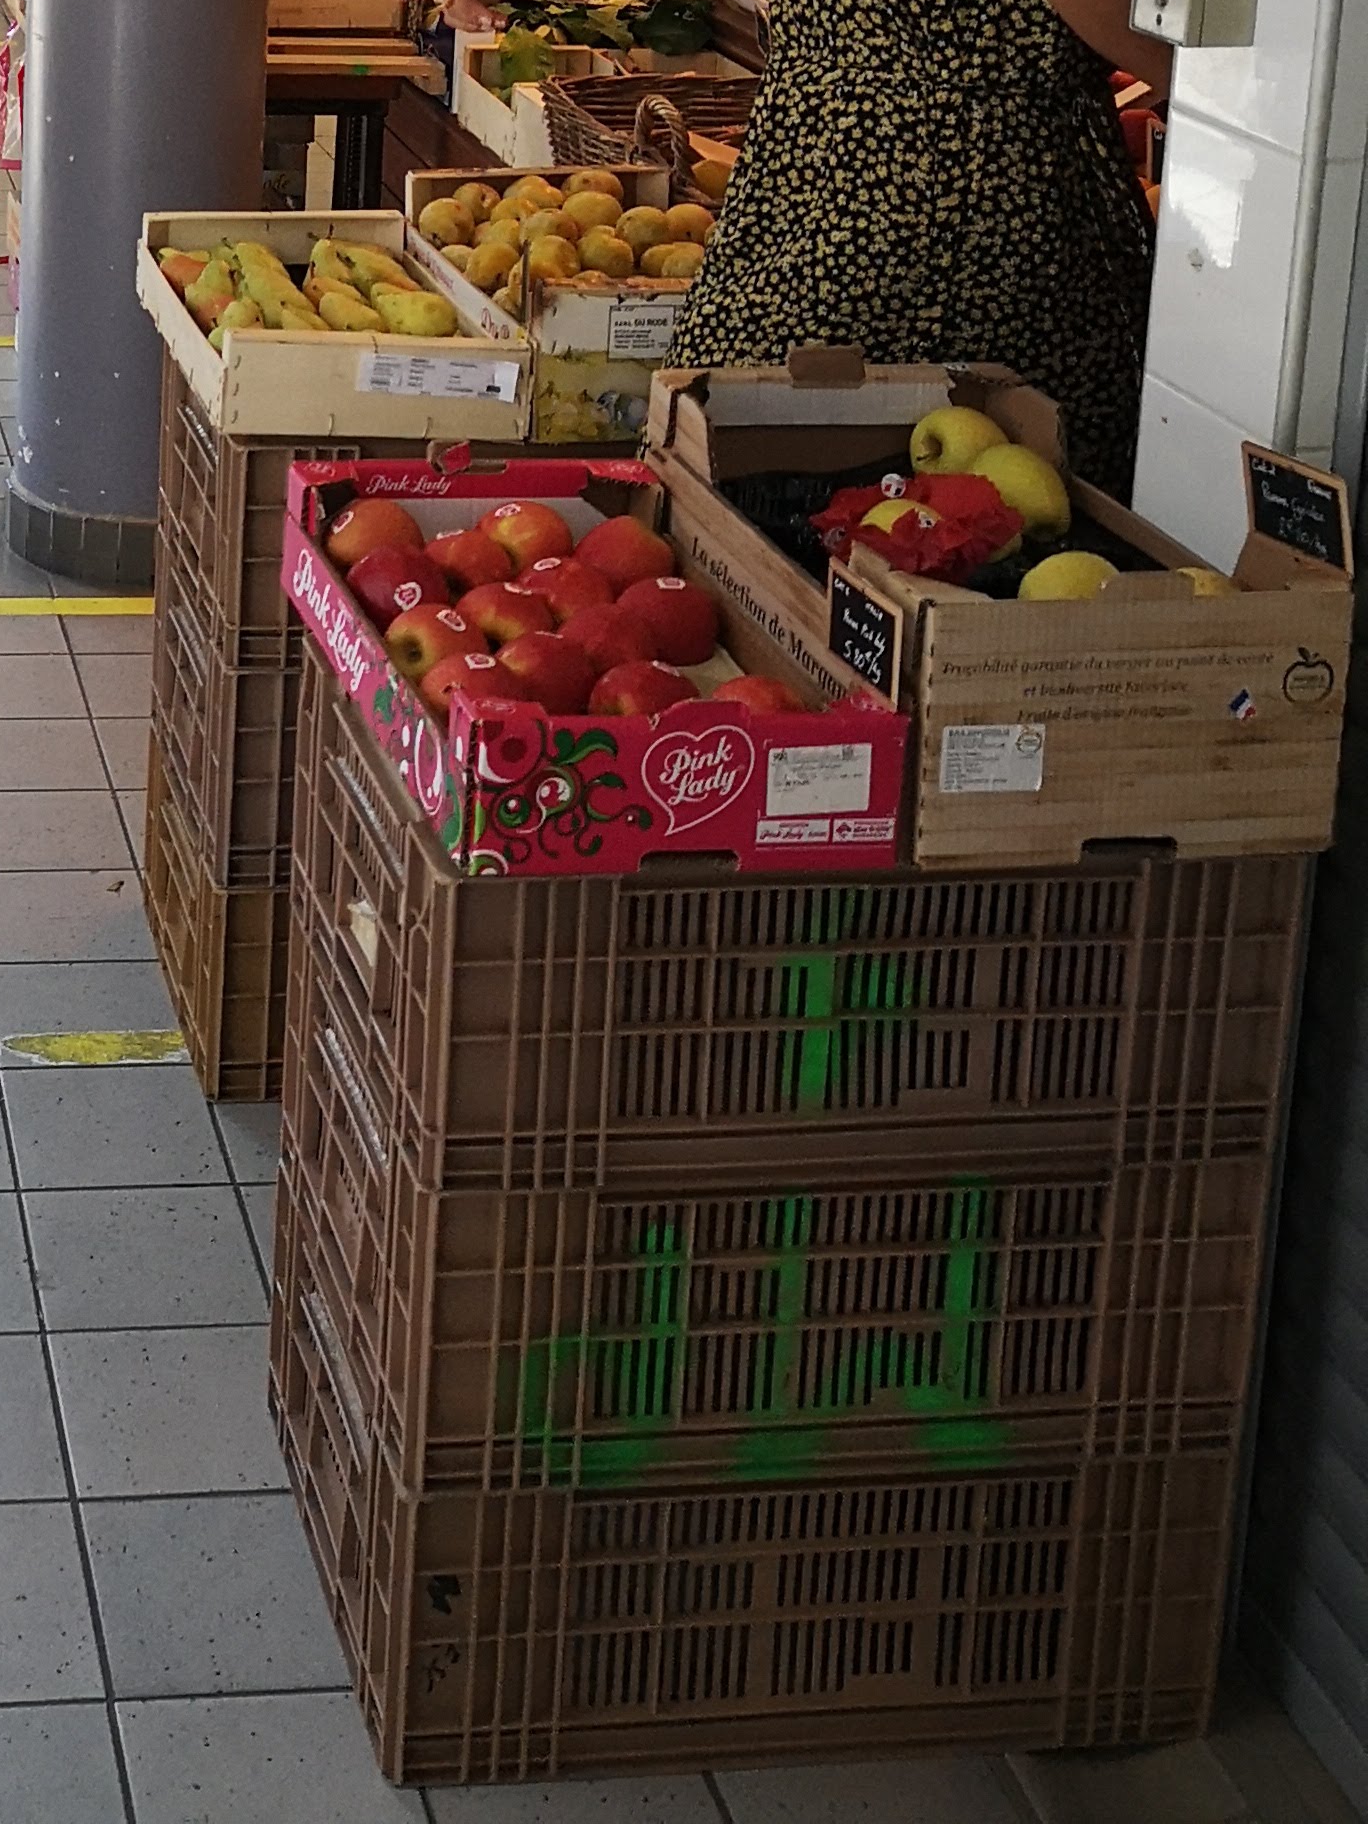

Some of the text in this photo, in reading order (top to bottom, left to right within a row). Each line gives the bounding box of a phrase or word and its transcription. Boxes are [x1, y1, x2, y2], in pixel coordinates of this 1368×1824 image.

[365, 474, 453, 496] Pink Lady
[293, 548, 367, 693] Pink Lady
[691, 536, 708, 567] La
[709, 559, 767, 626] sélection
[767, 613, 785, 643] de
[659, 735, 742, 806] Pink Lady
